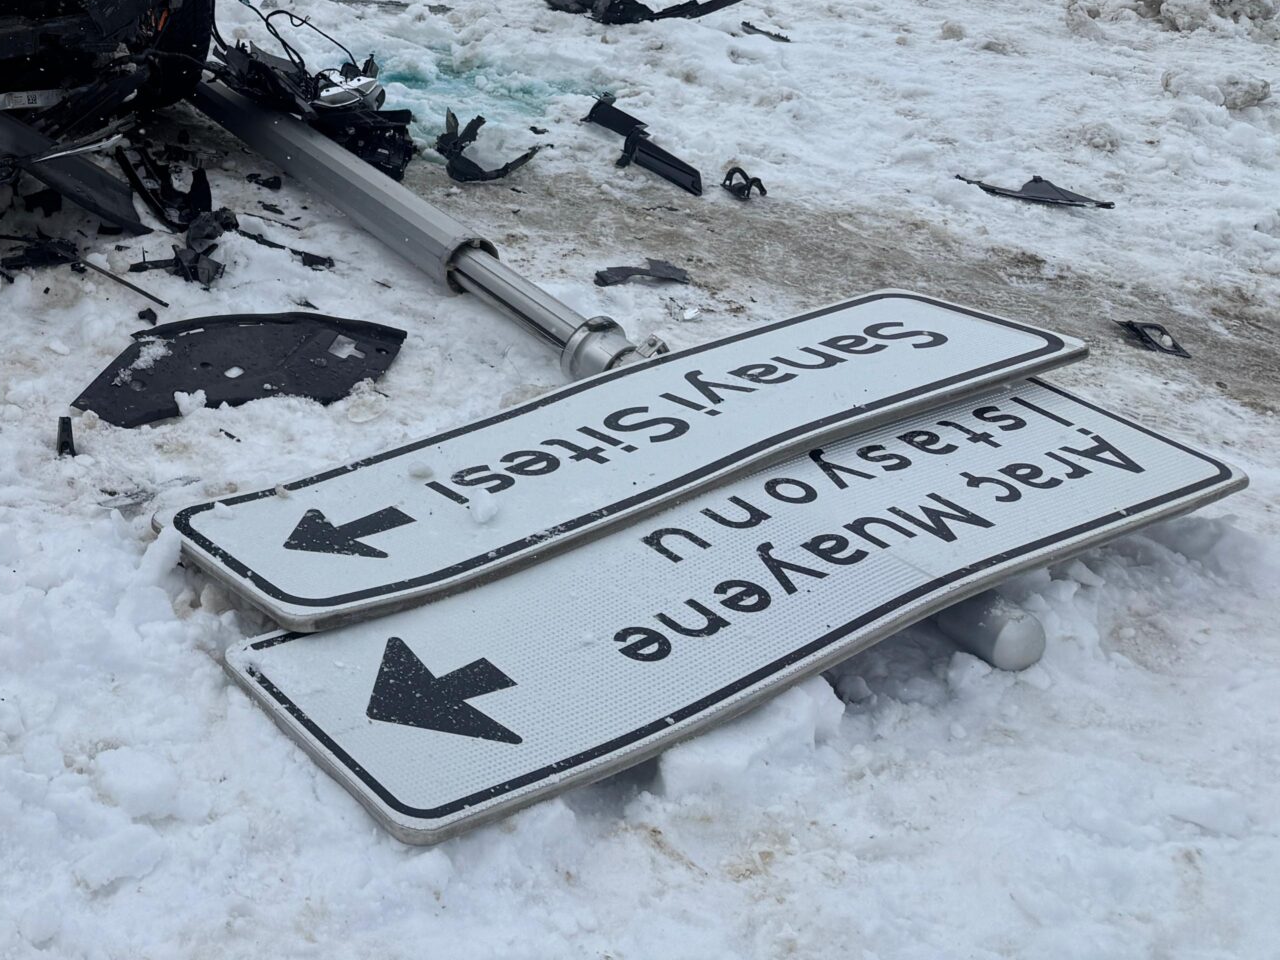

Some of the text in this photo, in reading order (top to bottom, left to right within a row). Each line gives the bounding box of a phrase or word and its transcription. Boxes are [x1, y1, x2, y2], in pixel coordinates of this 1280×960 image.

[425, 321, 949, 508] Sanayi Sitesi
[641, 396, 1095, 563] İstasyonu
[613, 435, 1146, 662] Araç Muayene
